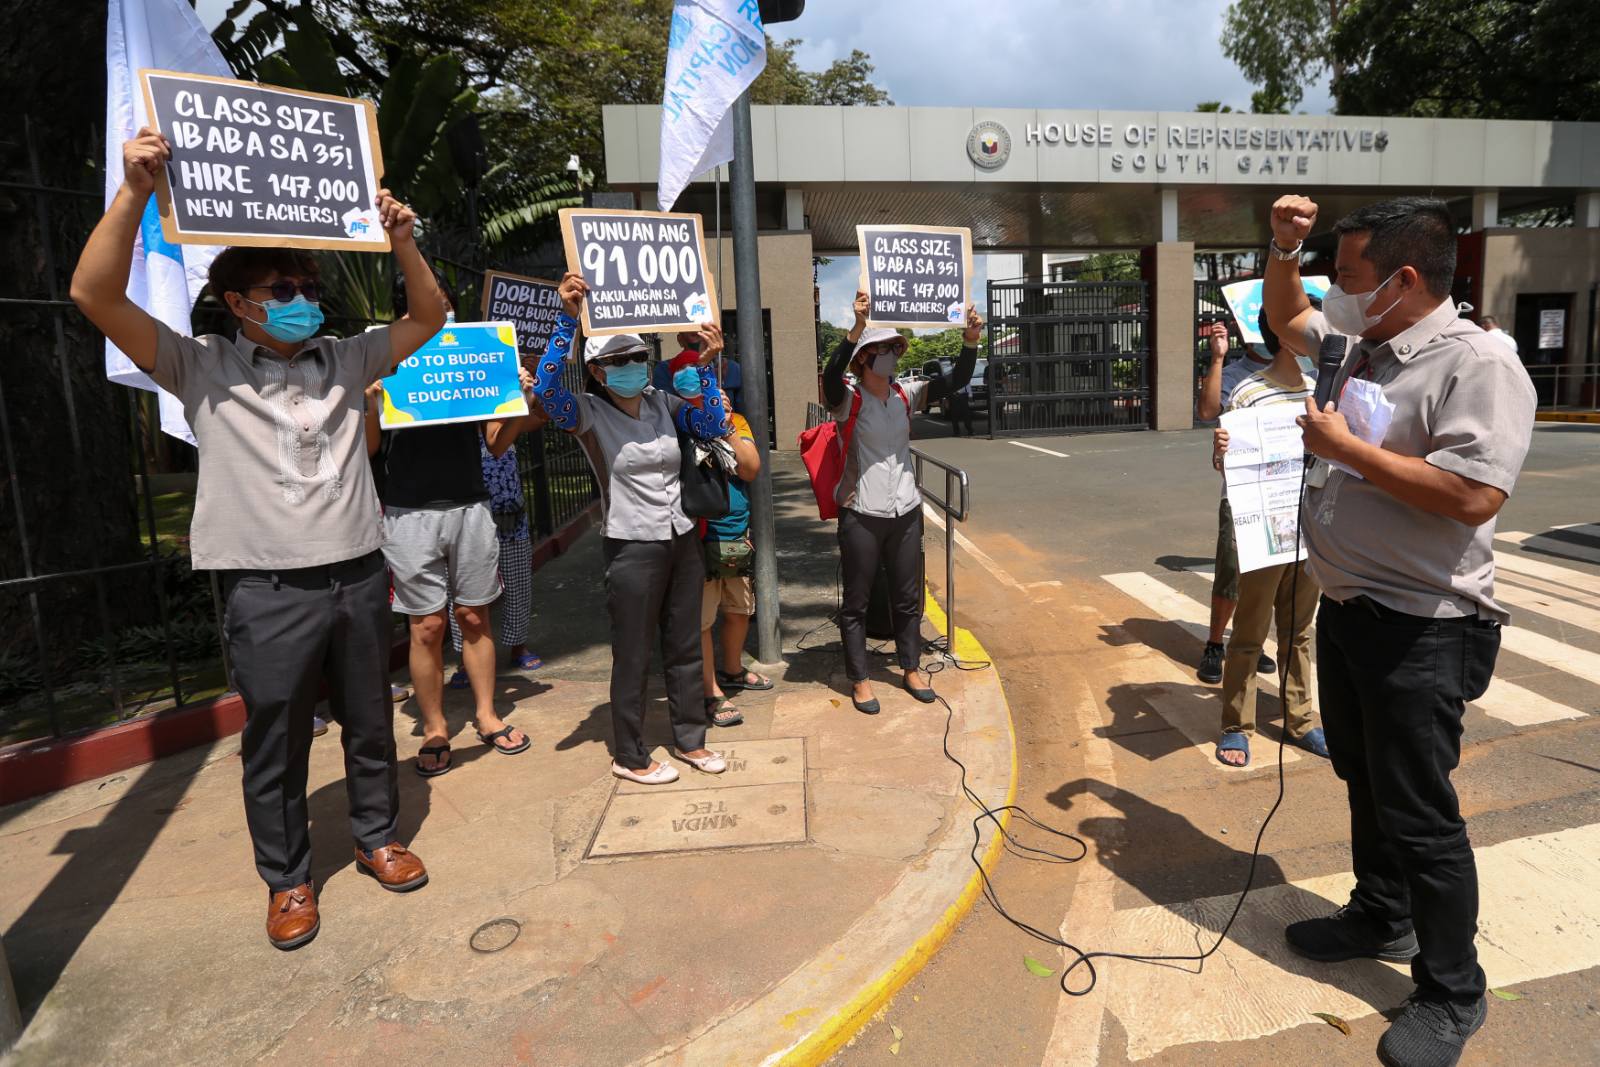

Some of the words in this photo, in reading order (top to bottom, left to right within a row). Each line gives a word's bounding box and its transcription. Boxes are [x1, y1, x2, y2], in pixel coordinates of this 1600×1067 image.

[174, 90, 270, 127] CLASS
[276, 105, 345, 141] SIZE,
[172, 120, 265, 158] IBABA
[270, 133, 308, 162] SA
[313, 143, 353, 170] 35!
[1025, 123, 1112, 147] HOUSE
[1124, 124, 1157, 148] OF
[1168, 125, 1389, 153] REPRESENTATIVES
[1111, 152, 1209, 174] SOUTH
[1237, 155, 1310, 175] GATE
[180, 160, 253, 194] HIRE
[268, 173, 359, 203] 147,000
[185, 198, 233, 217] NEW
[242, 201, 338, 227] TEACHERS!
[581, 221, 654, 242] PUNUAN
[658, 223, 690, 243] ANG
[874, 237, 918, 254] CLASS
[920, 239, 955, 258] SIZE,
[583, 242, 697, 287] 91,000
[873, 256, 913, 274] IBABA
[915, 258, 935, 275] SA
[937, 261, 958, 277] 35!
[494, 281, 563, 308] DOBLEHI
[592, 289, 663, 303] KAKULANGAN
[663, 289, 677, 300] SA
[875, 278, 906, 297] HIRE
[912, 283, 959, 300] 147,000
[492, 301, 525, 317] EDUC
[525, 306, 561, 321] BUDGE
[594, 303, 680, 320] SILID-ARALAN!
[874, 300, 896, 312] NEW
[899, 301, 945, 314] TEACHERS!
[422, 355, 444, 367] TO
[448, 352, 504, 365] BUDGET
[422, 371, 464, 384] CUTS
[467, 370, 486, 381] TO
[407, 386, 500, 404] EDUCATION!
[1234, 514, 1260, 527] REALITY
[682, 800, 728, 815] TEC
